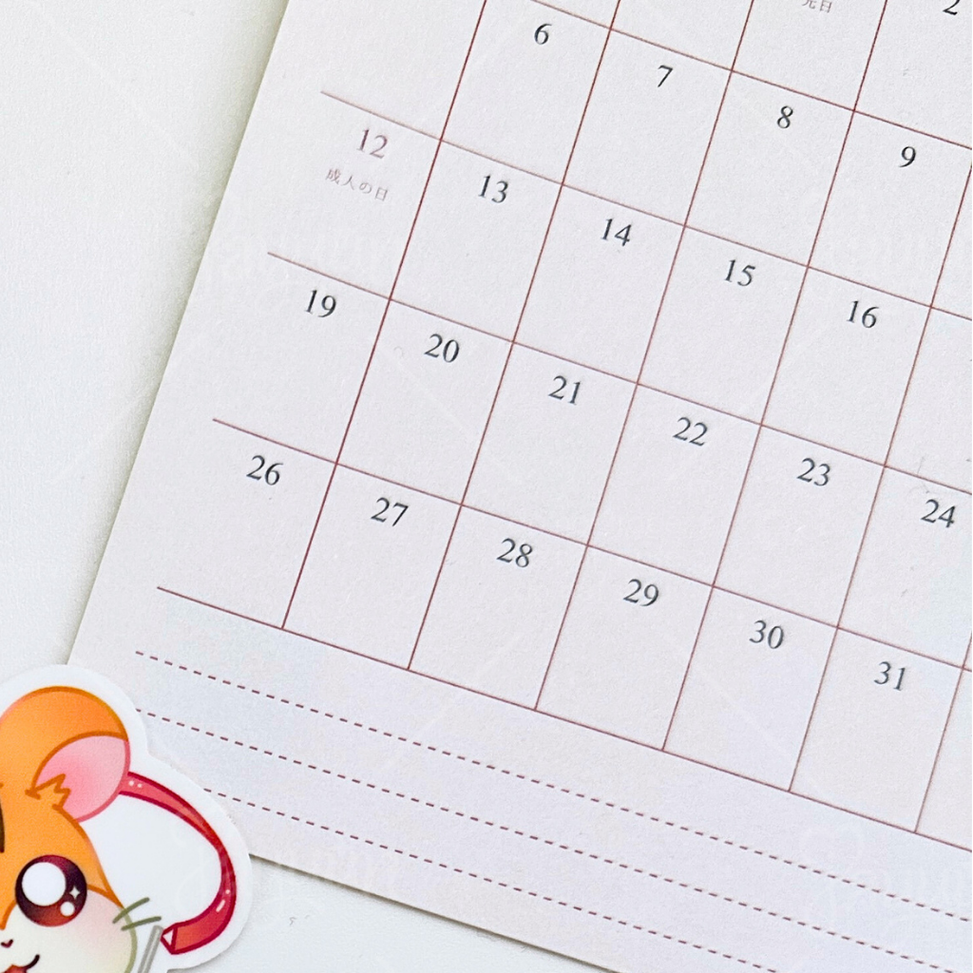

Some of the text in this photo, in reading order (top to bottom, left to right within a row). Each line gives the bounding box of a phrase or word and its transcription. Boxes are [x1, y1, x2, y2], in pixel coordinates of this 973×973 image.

[534, 23, 552, 45] 6
[657, 65, 674, 88] 7
[777, 105, 794, 129] 8
[357, 127, 388, 159] 12
[899, 146, 916, 168] 9
[325, 168, 389, 202] 成人の日
[478, 174, 509, 203] 13
[601, 218, 633, 247] 14
[724, 259, 756, 287] 15
[305, 289, 337, 318] 19
[846, 300, 879, 328] 16
[424, 333, 460, 363] 20
[548, 375, 581, 405] 21
[672, 417, 708, 446] 22
[246, 455, 283, 486] 26
[797, 457, 831, 486] 23
[370, 497, 409, 527] 27
[921, 499, 956, 528] 24
[496, 538, 533, 568] 28
[623, 579, 660, 607] 29
[749, 620, 785, 649] 30
[874, 661, 907, 691] 31
